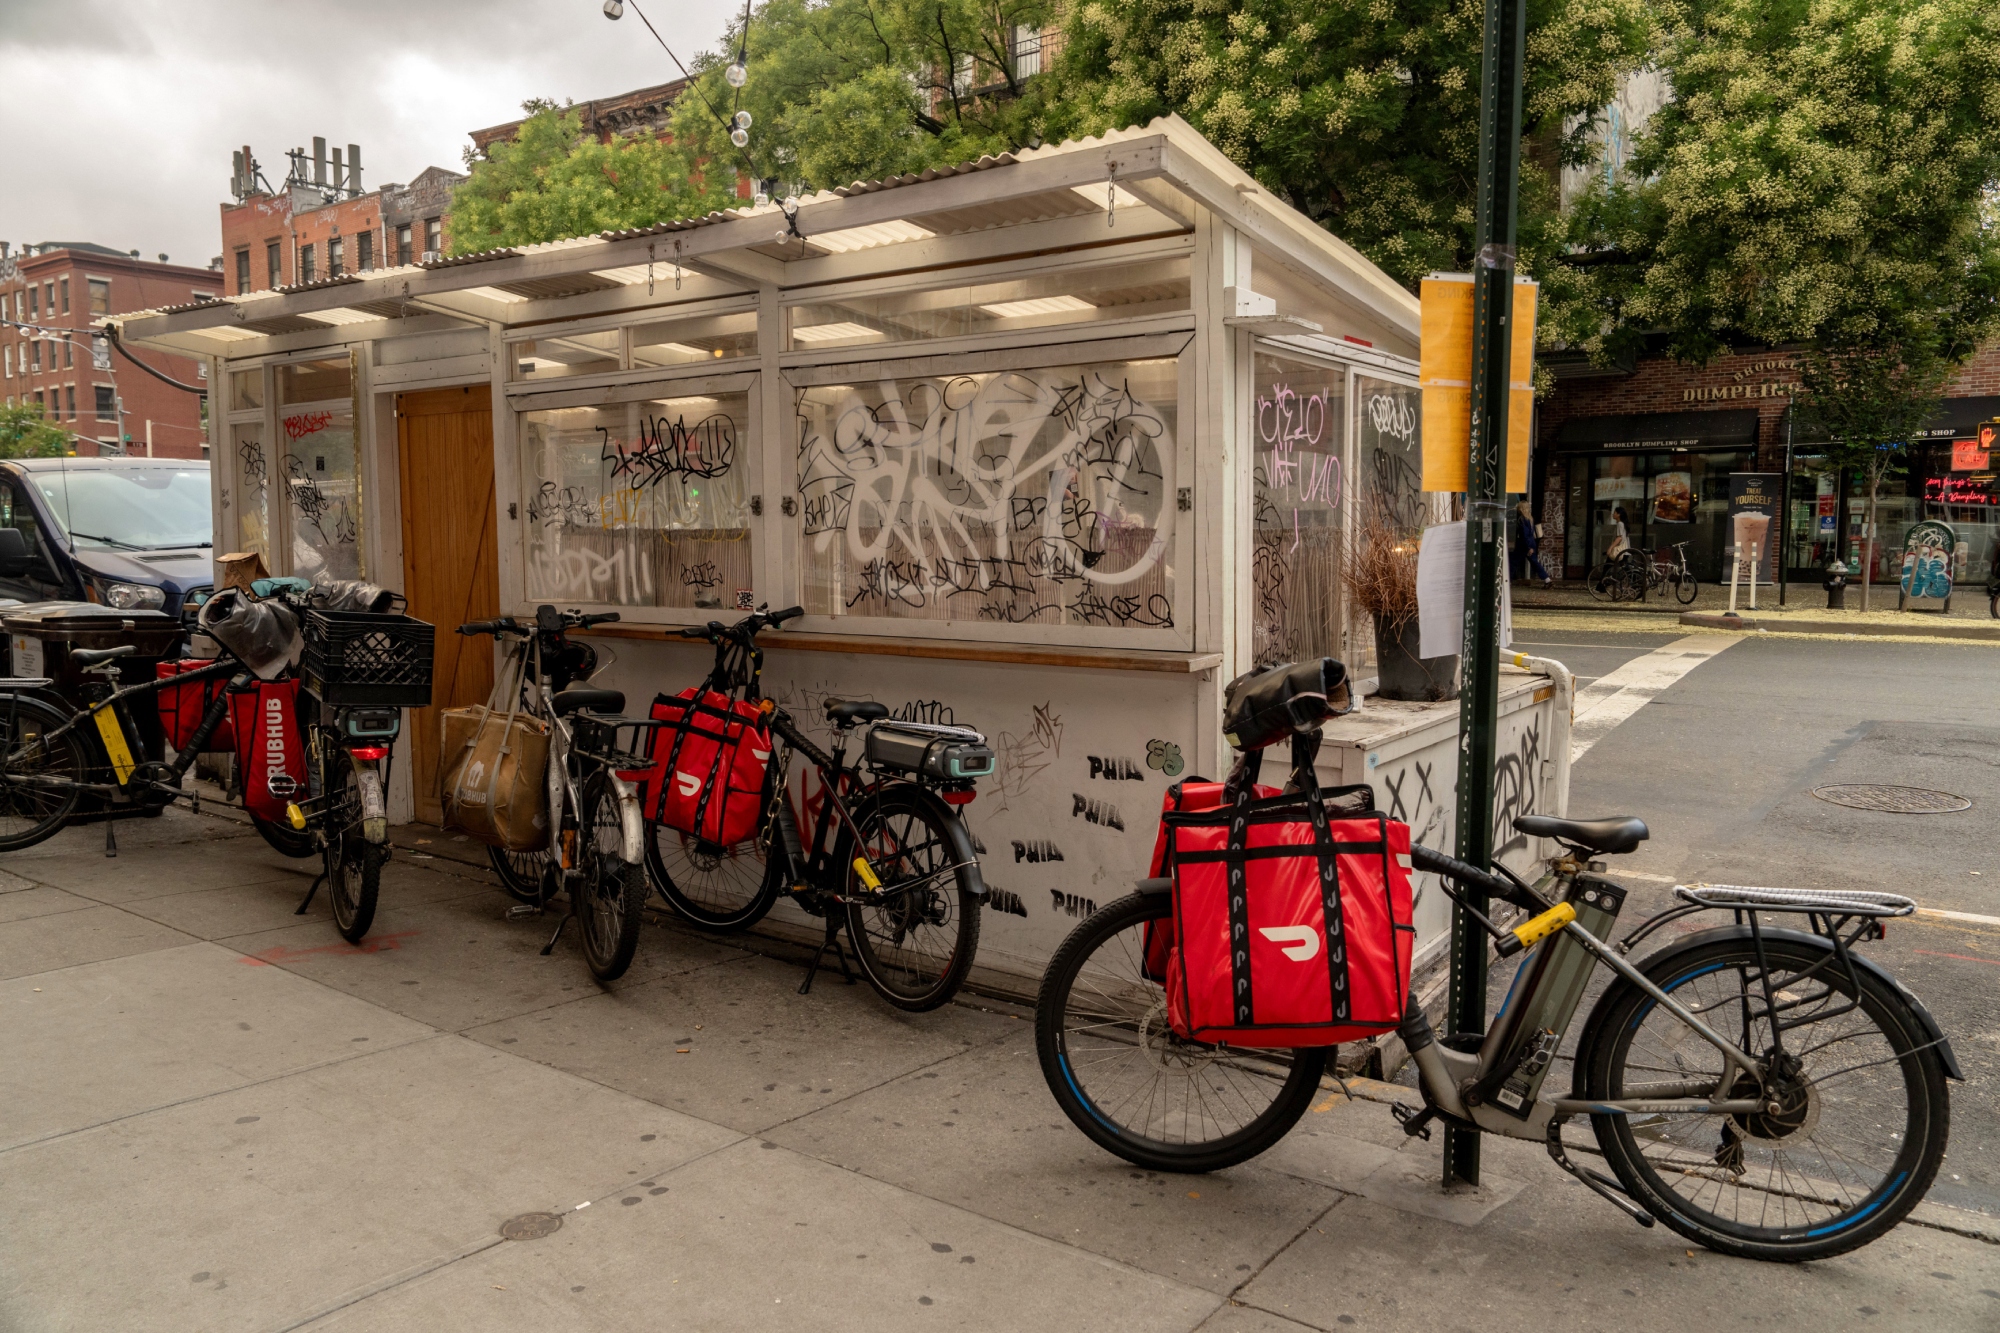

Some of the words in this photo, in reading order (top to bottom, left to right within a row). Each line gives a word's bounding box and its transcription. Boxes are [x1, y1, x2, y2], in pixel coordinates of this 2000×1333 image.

[1931, 429, 1956, 437] SHOP
[1603, 441, 1640, 449] BROOKLYN
[1642, 440, 1678, 448] DUMPLING
[1680, 439, 1699, 447] SHOP
[1734, 494, 1773, 506] YOURSELF
[266, 698, 287, 778] RUBHUB
